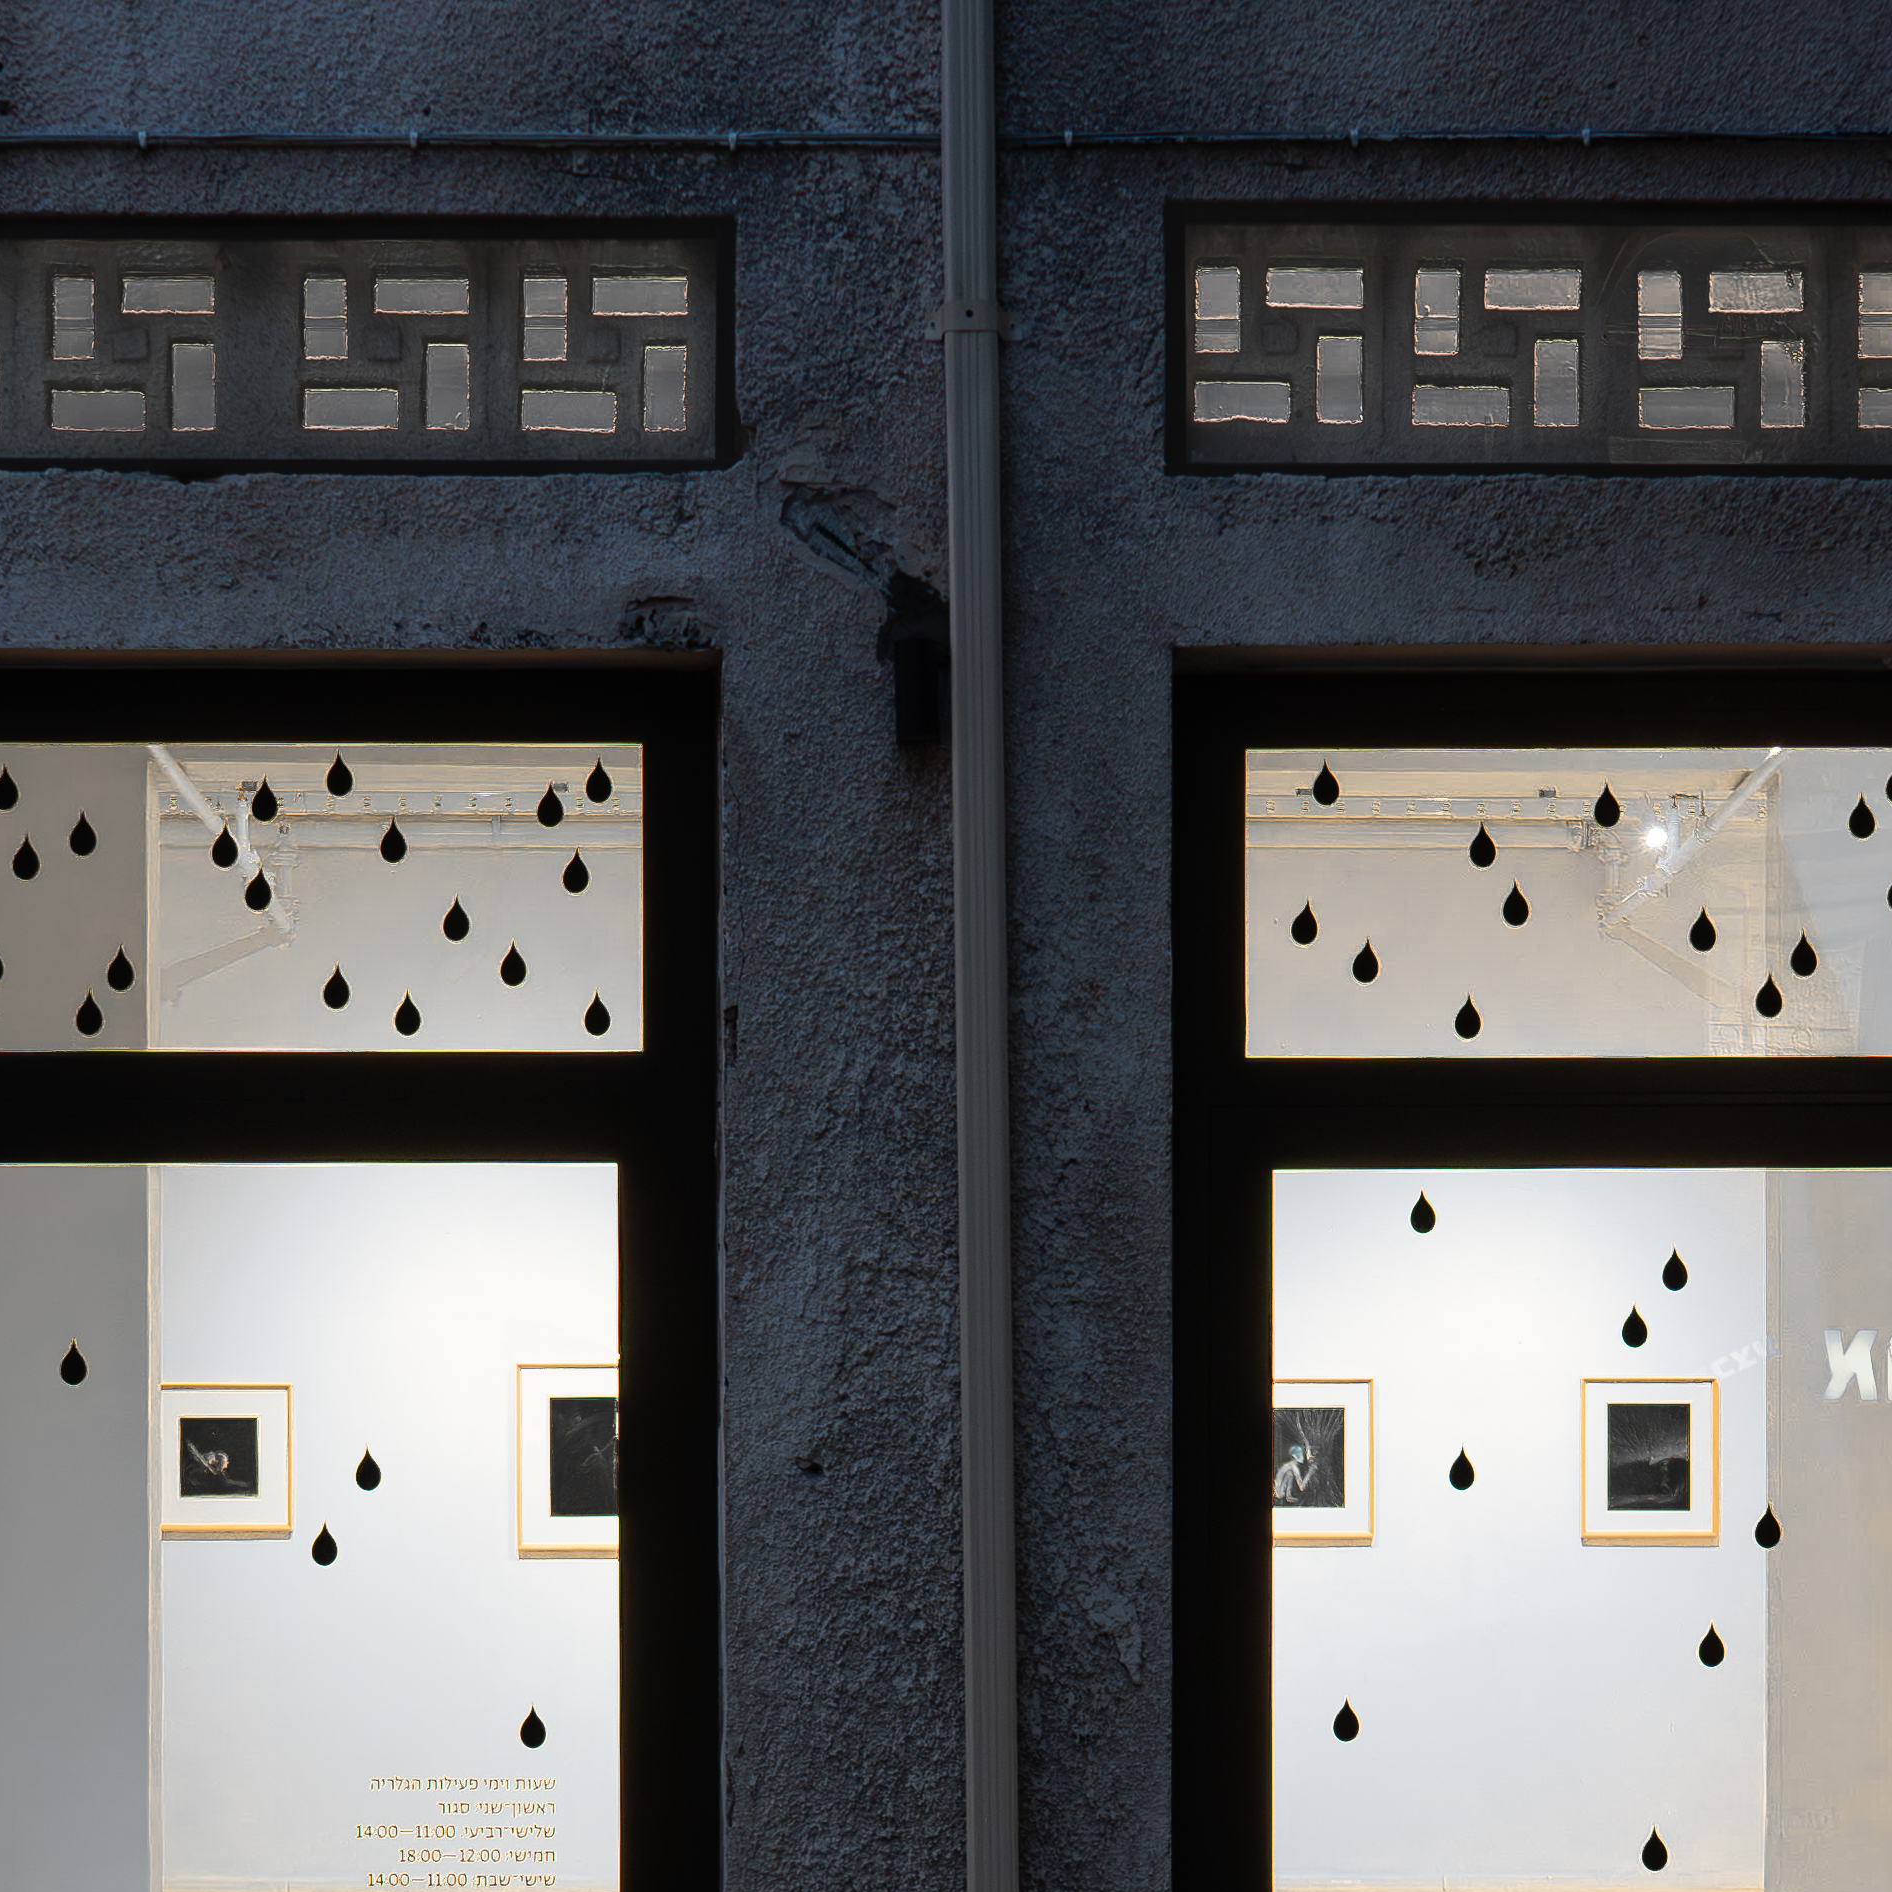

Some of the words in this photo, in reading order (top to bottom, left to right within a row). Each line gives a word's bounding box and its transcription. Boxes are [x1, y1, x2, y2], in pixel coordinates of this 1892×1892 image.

[369, 1776, 421, 1791] הגלריה
[426, 1776, 479, 1791] פעילות
[483, 1777, 510, 1791] וימי
[514, 1777, 556, 1791] שעות
[437, 1801, 470, 1815] סגור
[504, 1849, 556, 1863] חמישי:
